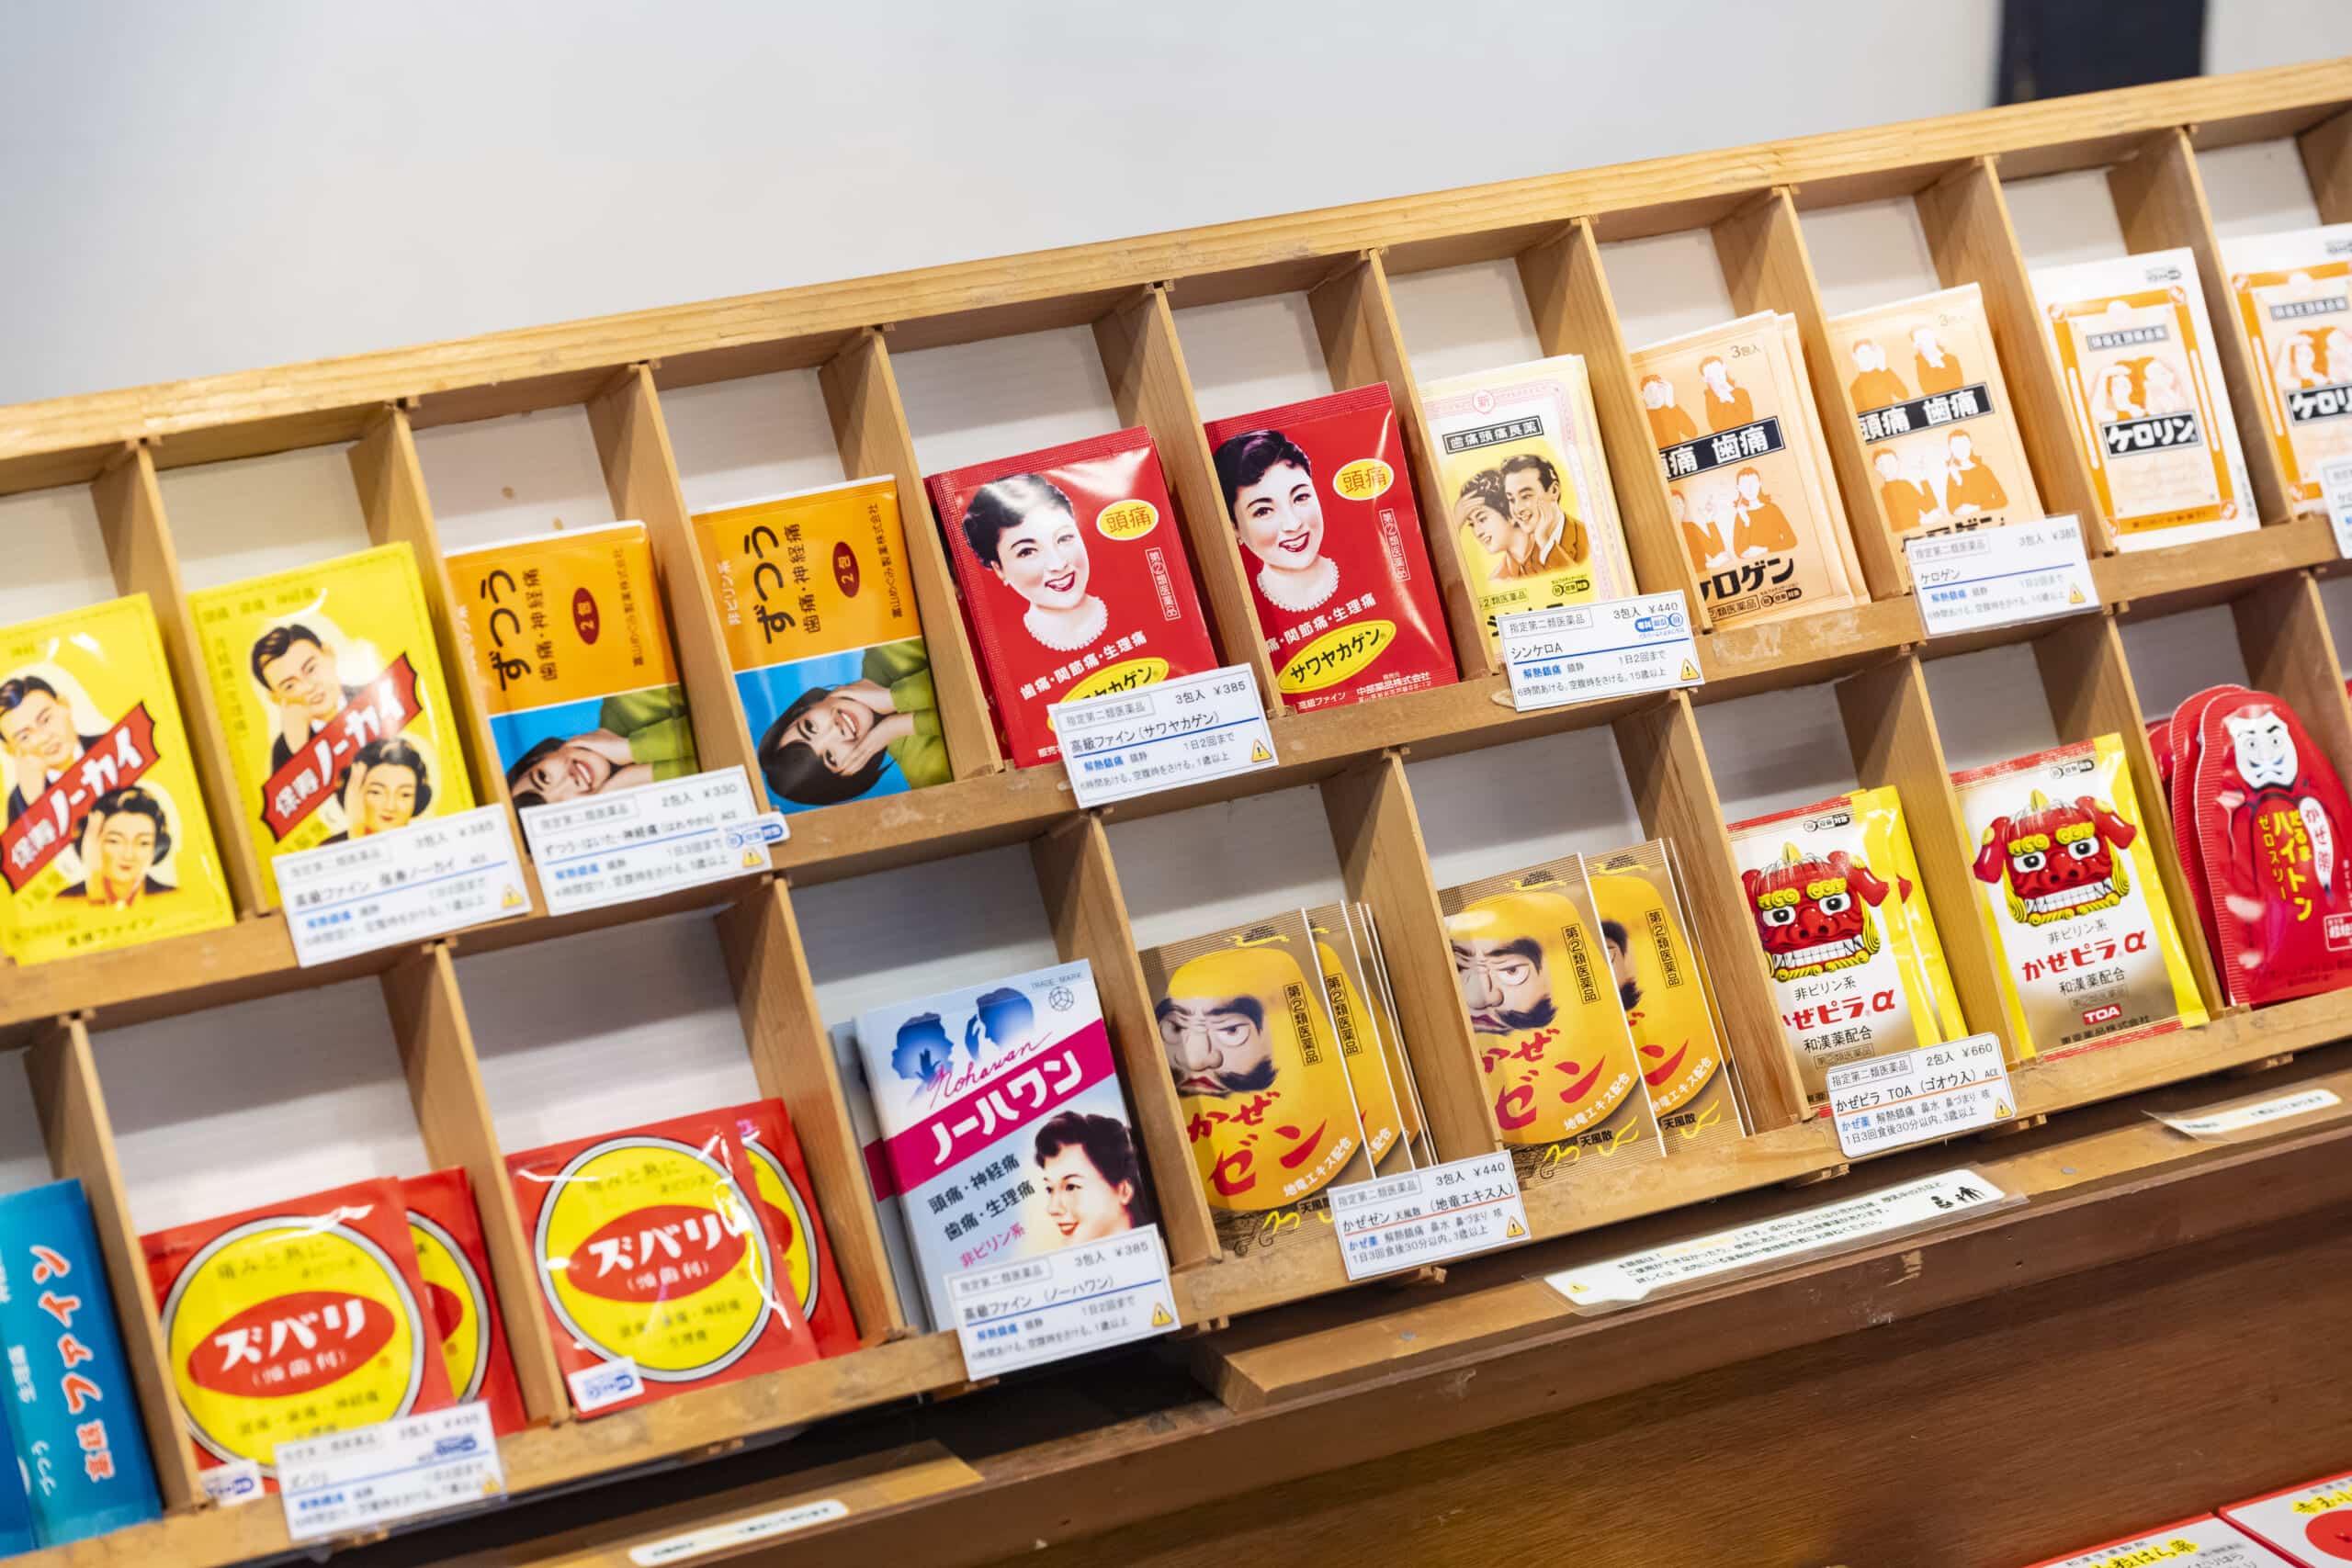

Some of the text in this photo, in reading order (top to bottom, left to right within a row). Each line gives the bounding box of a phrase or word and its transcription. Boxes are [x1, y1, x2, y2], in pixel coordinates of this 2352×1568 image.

[1923, 390, 1979, 425] 歯痛
[1712, 425, 1770, 464] 歯痛
[2108, 418, 2196, 453] ケロリン
[1341, 466, 1387, 494] 頭痛
[1104, 505, 1151, 533] 頭痛
[744, 525, 797, 644] ずつう
[784, 523, 821, 635] 歯痛・神経痛
[838, 554, 855, 585] 2包
[1920, 569, 1961, 584] ケロゲン
[1613, 607, 1642, 620] 3包入
[1648, 602, 1679, 614] ¥440
[481, 570, 532, 693] ずつう
[1020, 630, 1148, 701] 歯痛・関節痛・生理痛
[1290, 628, 1380, 683] サワヤカゲン
[1510, 642, 1563, 660] シンケロA
[1175, 690, 1205, 705] 3包入
[1214, 681, 1247, 696] ¥385
[2258, 814, 2287, 900] ゼロスリー
[2273, 810, 2312, 922] ハイトン
[2048, 920, 2109, 944] 非ピリン系
[1794, 976, 1857, 1000] 非ピリン系
[2059, 967, 2125, 995] 和漢薬配合
[1782, 988, 1896, 1031] ぜピラα
[2085, 1007, 2120, 1022] TOA
[1804, 1026, 1872, 1053] 和漢薬配合
[1832, 1043, 1993, 1087] 指定第二類医薬品 2包入 ¥660
[931, 1050, 1082, 1166] ノーハワン
[1837, 1092, 1881, 1112] かぜピラ
[1887, 1086, 1913, 1100] TOA
[1663, 1112, 1697, 1130] 天風散
[1842, 1116, 1871, 1132] かぜ薬
[1580, 1131, 1613, 1148] 天風散
[929, 1154, 1021, 1214] 頭痛・神経痛
[1436, 1171, 1465, 1186] 3包入
[1474, 1162, 1506, 1178] ¥440
[944, 1179, 1035, 1242] 歯痛・生理痛
[1343, 1213, 1389, 1232] かぜゼン
[588, 1214, 722, 1278] ズバリ
[960, 1223, 1025, 1268] 非ピリン系
[214, 1299, 365, 1372] ズバリ
[29, 1244, 116, 1483] 高級ファイン
